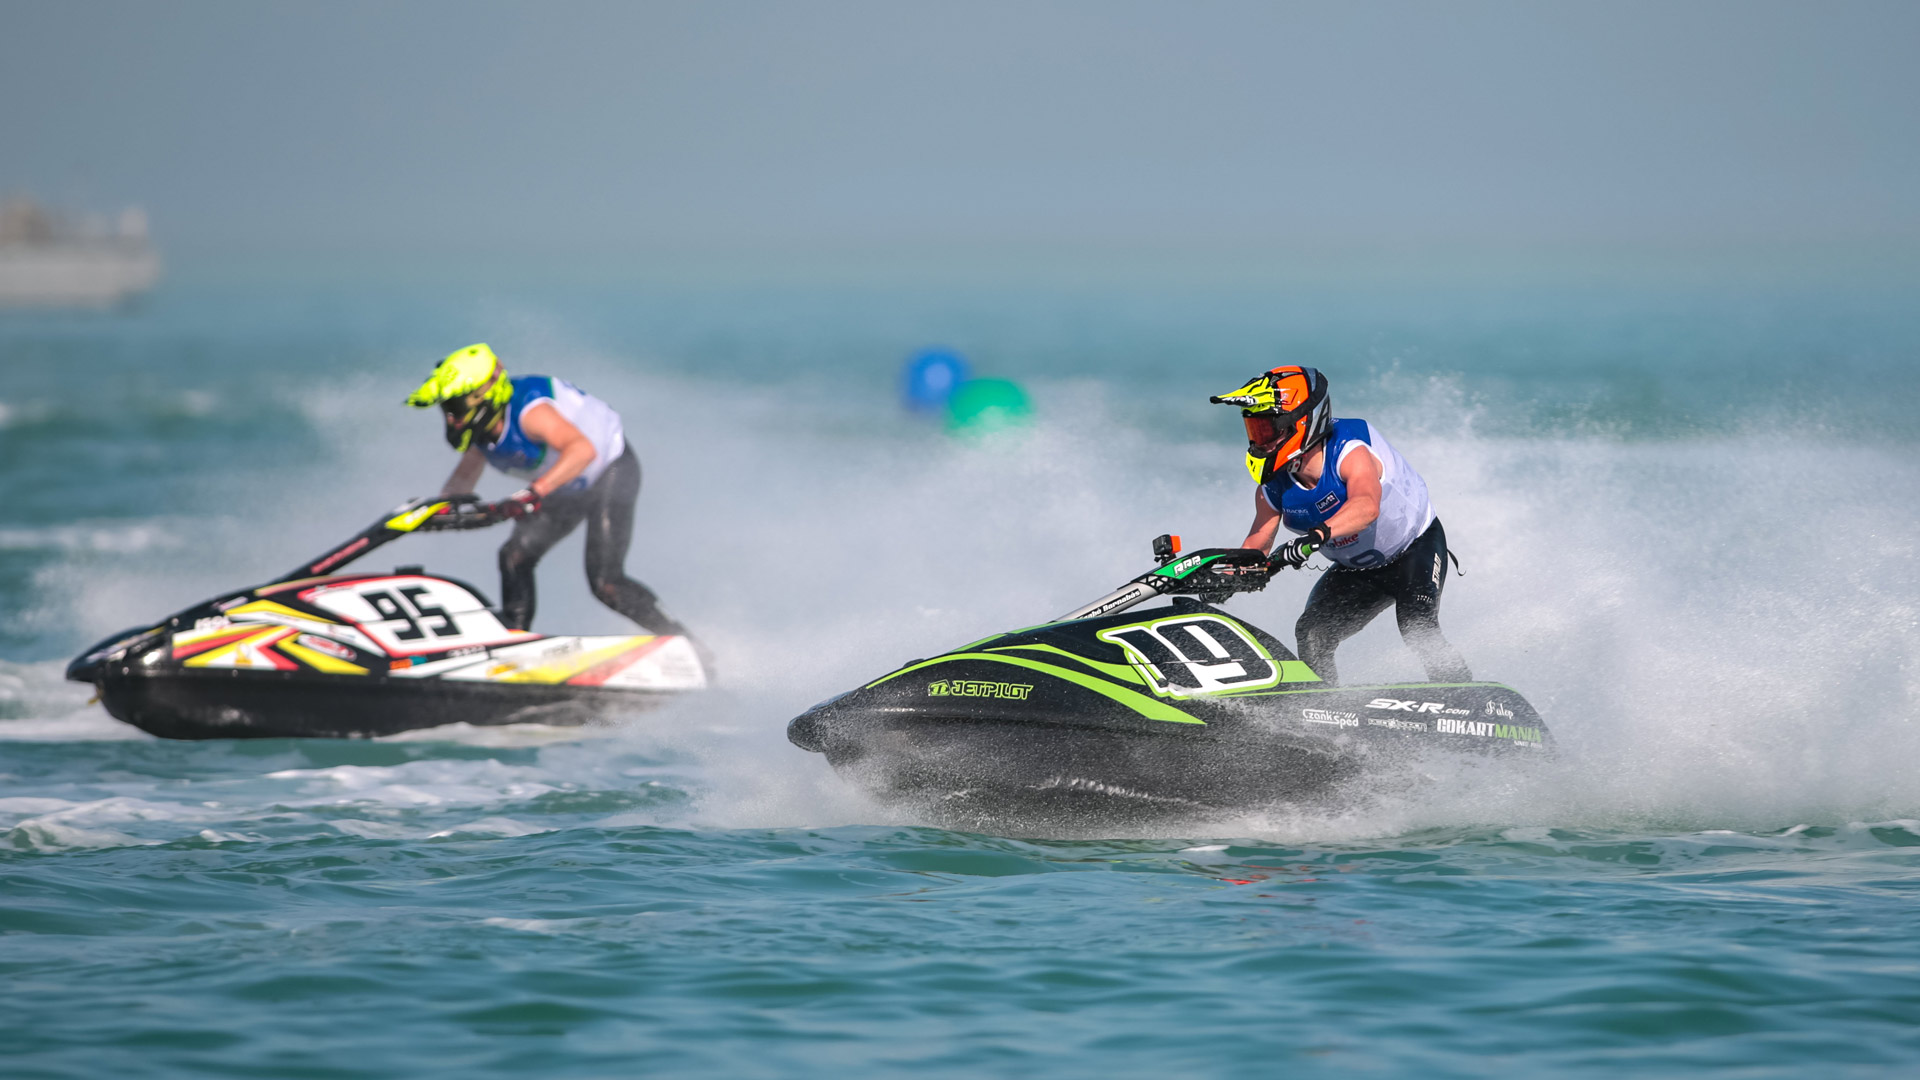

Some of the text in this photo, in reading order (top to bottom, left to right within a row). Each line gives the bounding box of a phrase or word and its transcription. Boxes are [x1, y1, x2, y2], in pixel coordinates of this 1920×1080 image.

[361, 585, 462, 641] 95
[951, 680, 1034, 700] JETPILOT
[1365, 698, 1470, 716] SX-R.com
